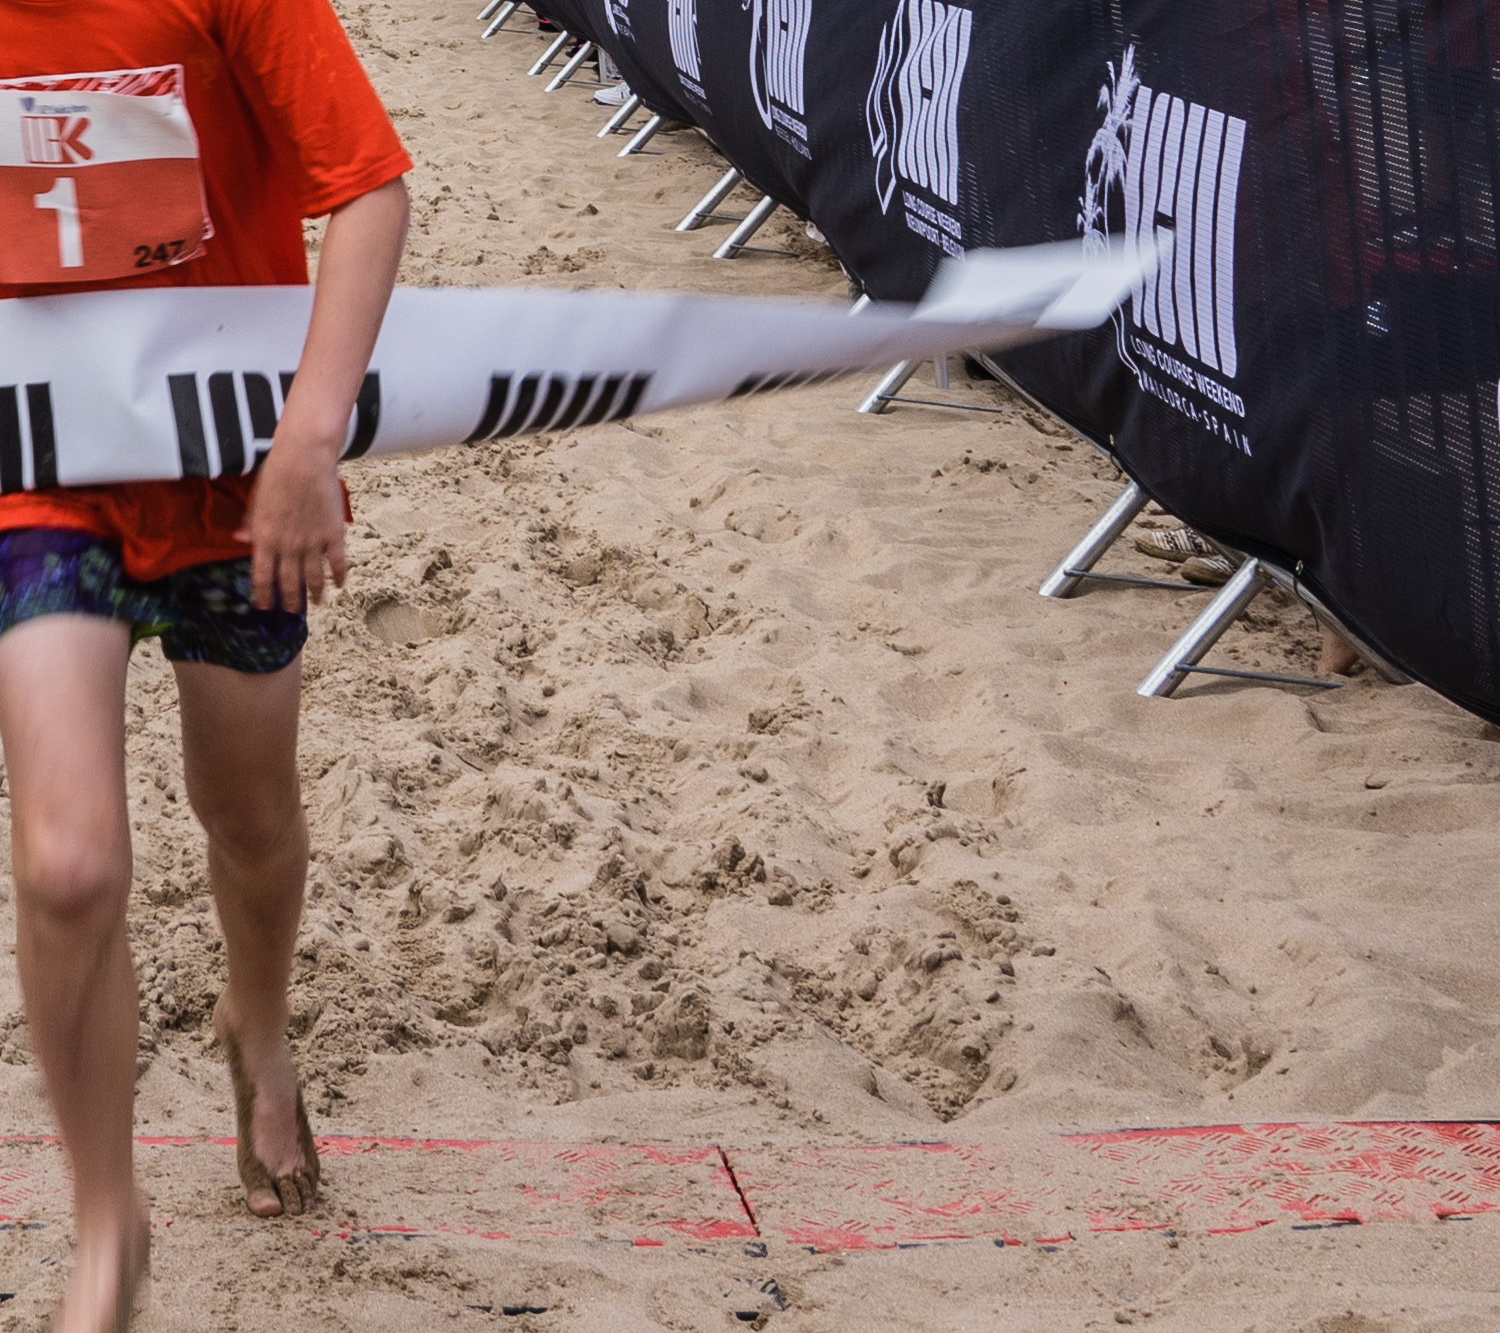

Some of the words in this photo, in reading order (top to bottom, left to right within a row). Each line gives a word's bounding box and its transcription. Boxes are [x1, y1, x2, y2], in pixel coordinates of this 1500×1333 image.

[33, 177, 85, 268] 1
[1130, 335, 1157, 366] LONG
[1158, 350, 1195, 390] COURSE
[1195, 371, 1245, 418] WEEKEND
